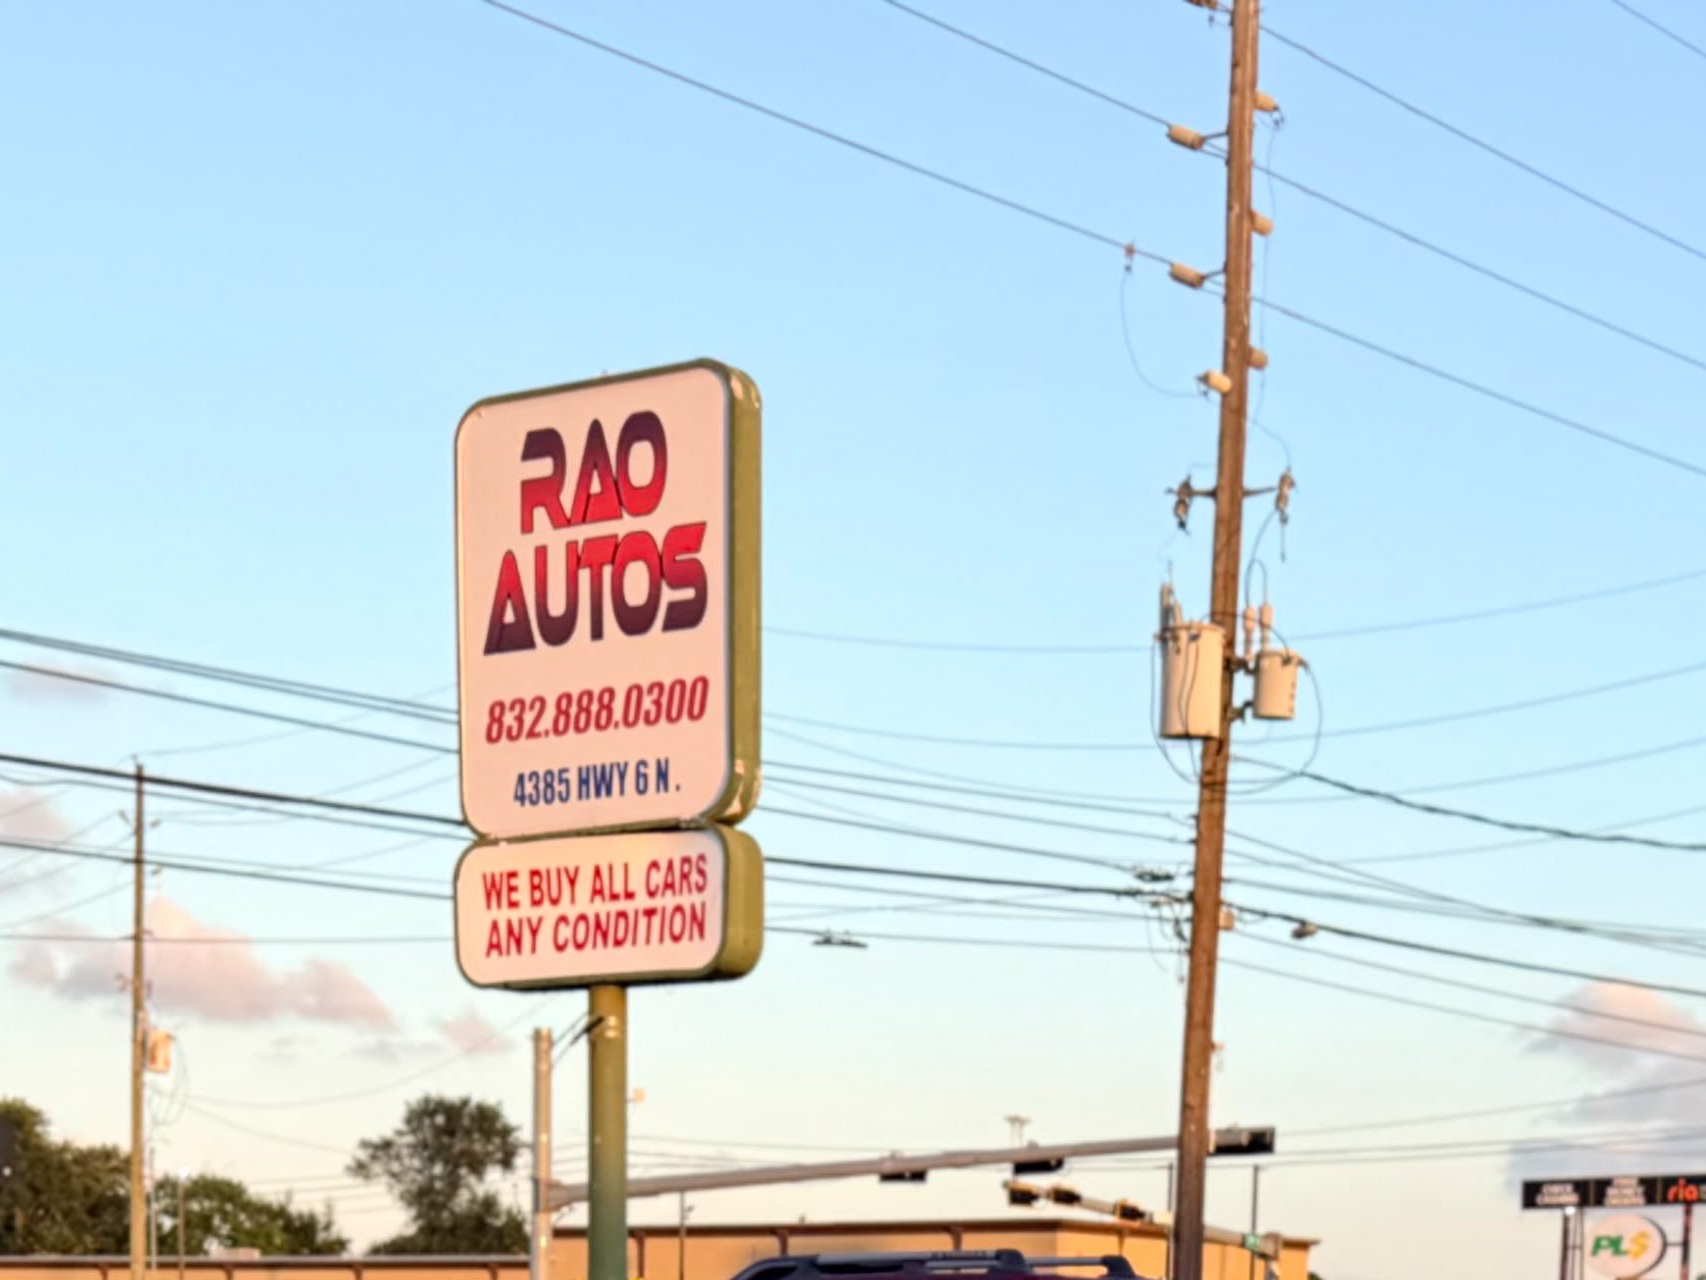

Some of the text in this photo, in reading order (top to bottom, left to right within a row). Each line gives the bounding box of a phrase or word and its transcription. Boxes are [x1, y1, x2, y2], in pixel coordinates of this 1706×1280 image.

[521, 410, 668, 535] RAO
[483, 521, 708, 656] AUTOS
[485, 675, 710, 745] 832.888.0300
[513, 767, 571, 807] 4385
[577, 761, 629, 801] HWY
[635, 758, 649, 796] 6
[483, 853, 708, 911] WE BUY ALL CARS
[485, 902, 707, 958] ANY CONDITION
